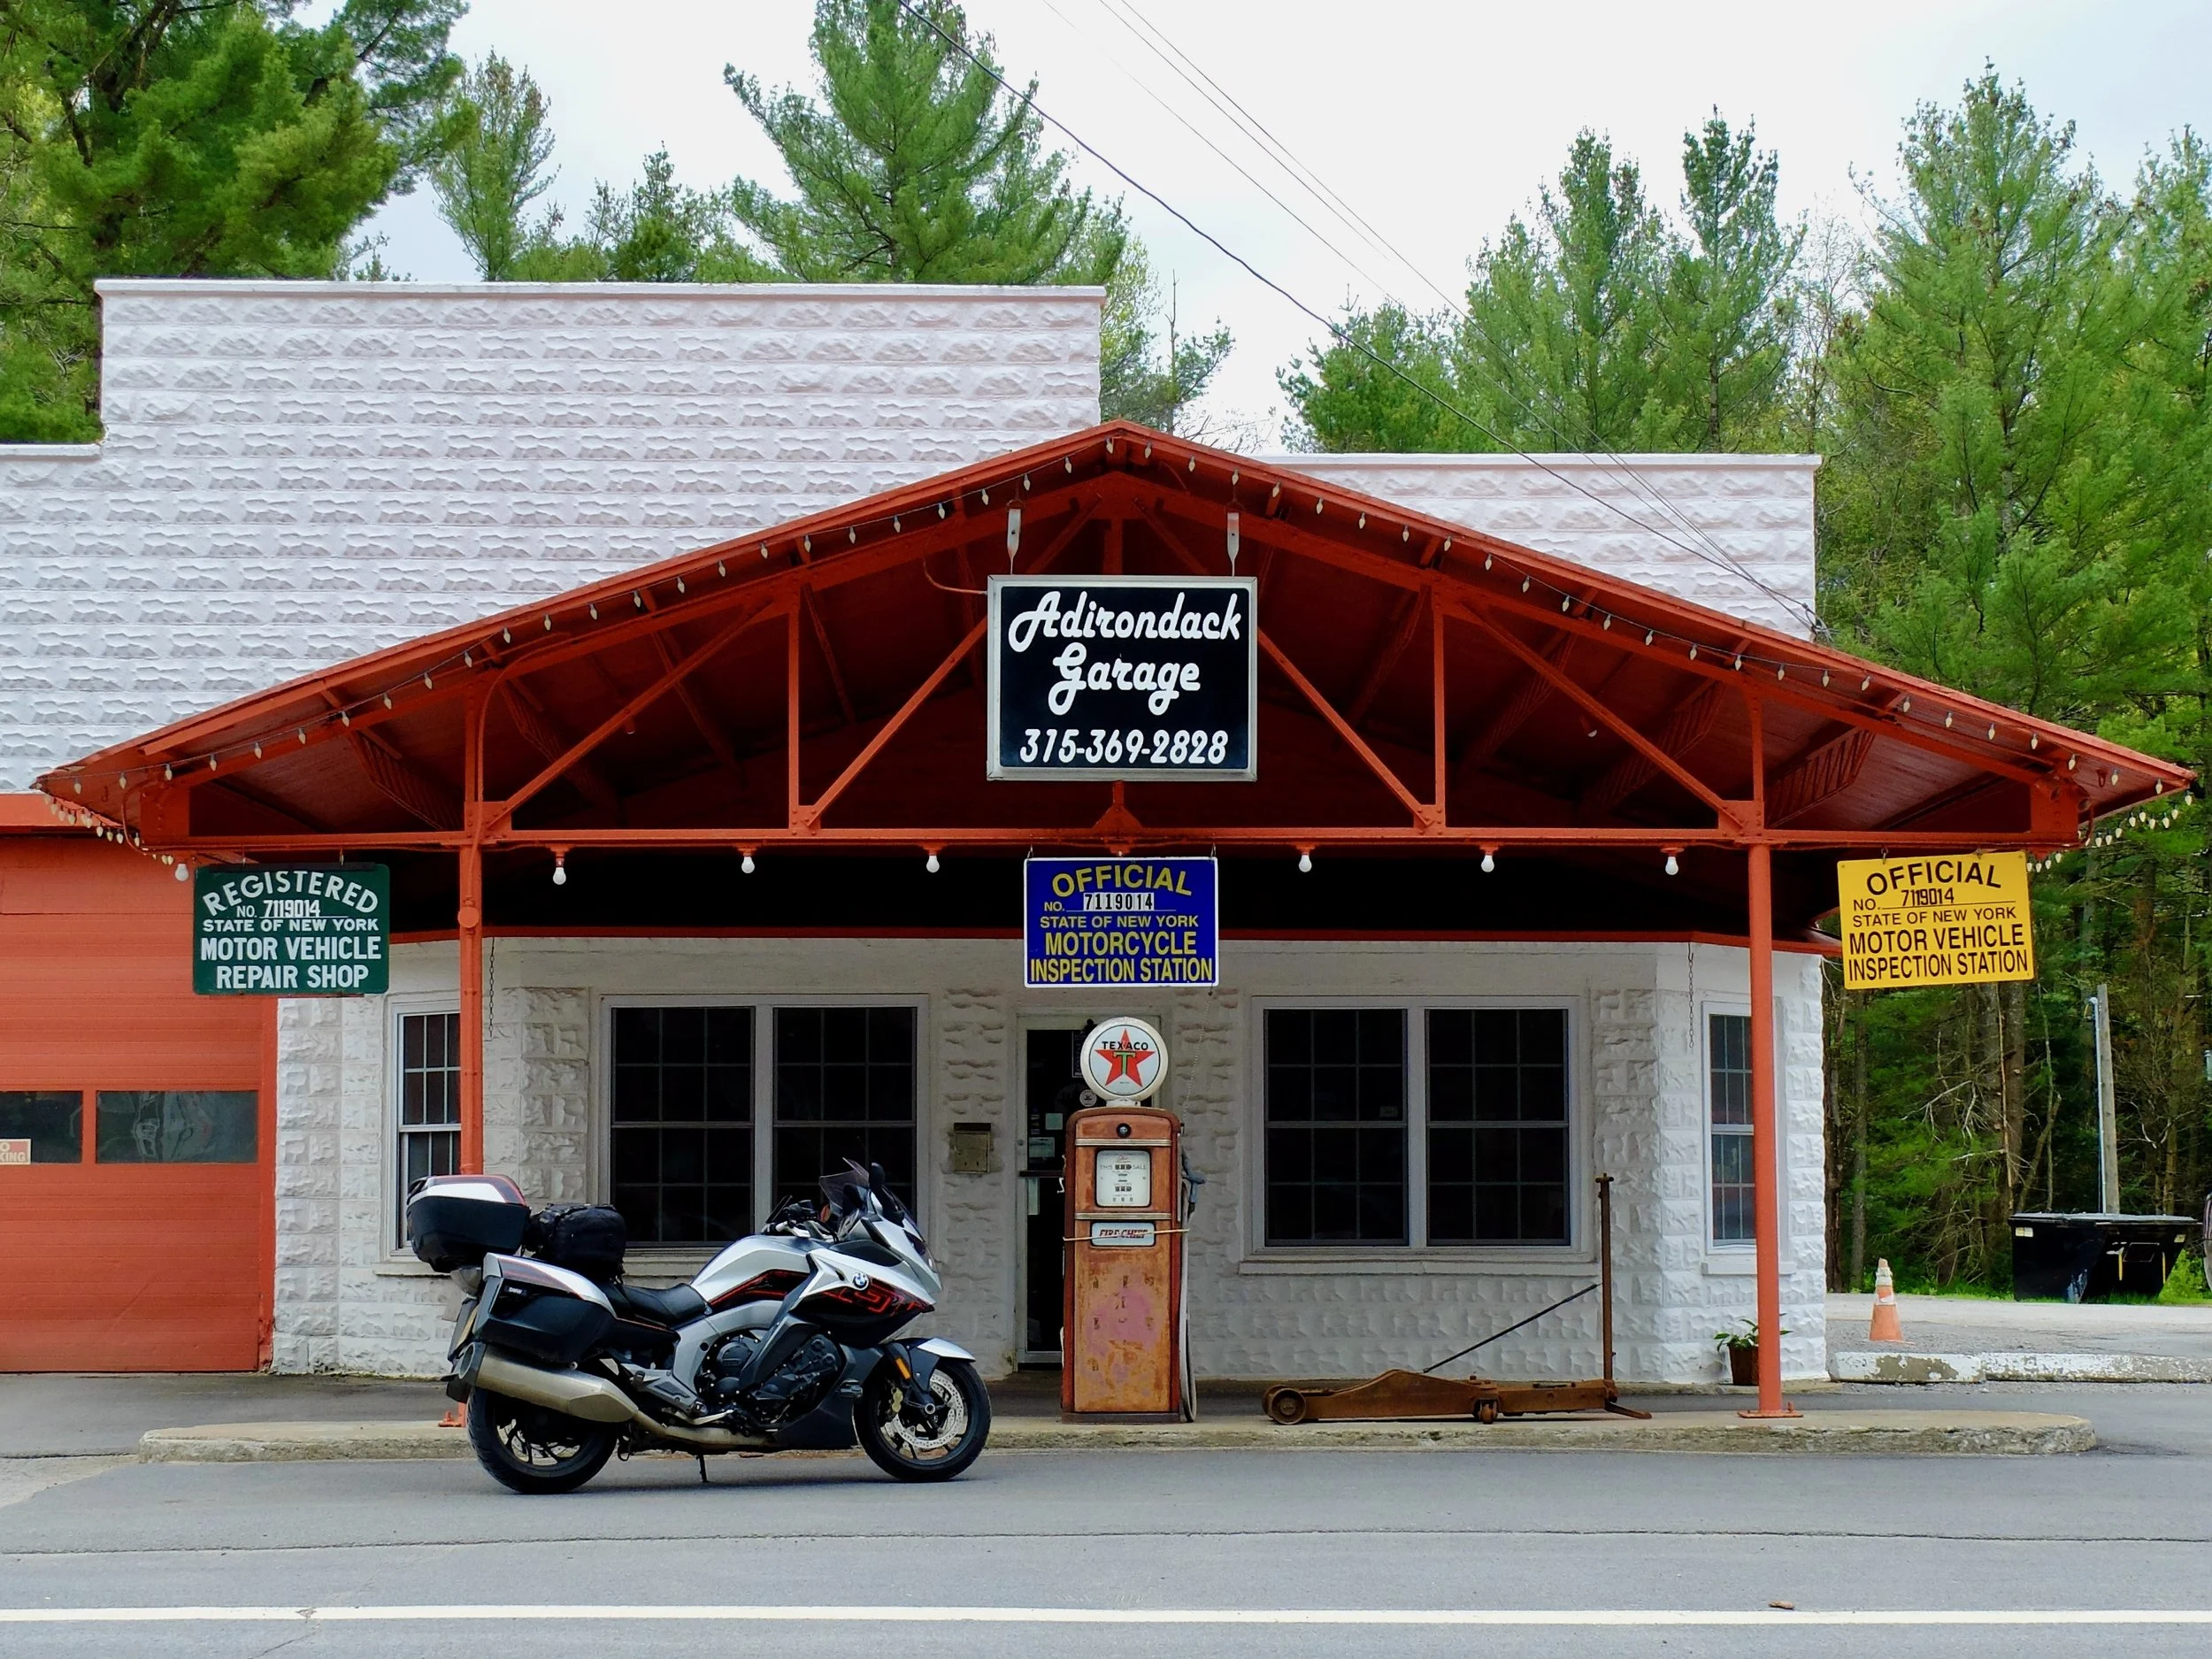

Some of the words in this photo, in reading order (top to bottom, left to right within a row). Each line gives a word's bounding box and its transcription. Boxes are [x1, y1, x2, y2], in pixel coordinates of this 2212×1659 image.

[1008, 590, 1241, 653] Adirondack
[1048, 641, 1202, 716] Garage
[1019, 728, 1229, 764] 315-369-2828
[1052, 864, 1193, 897] OFFICIAL
[1866, 860, 2002, 895] OFFICIAL
[203, 870, 379, 917] REGISTERED
[1044, 901, 1065, 912] NO.
[1084, 893, 1153, 910] 7119014
[1853, 898, 1881, 911] NO.
[1901, 887, 1955, 907] 7119014
[236, 904, 257, 918] NO.
[263, 899, 321, 918] 7119014
[1852, 912, 1901, 927] STATE
[1907, 910, 1928, 924] OF
[1932, 909, 1967, 923] NEW
[1974, 906, 2017, 920] YORK
[203, 918, 255, 933] STATE
[260, 918, 283, 932] OF
[289, 918, 326, 932] NEW
[333, 918, 380, 931] YORK
[1040, 916, 1087, 928] STATE
[1091, 916, 1112, 928] OF
[1117, 915, 1151, 927] NEW
[1156, 915, 1199, 927] YORK
[200, 936, 278, 961] MOTOR
[284, 935, 382, 960] VEHICLE
[1045, 931, 1197, 956] MOTORCYCLE
[1849, 928, 1928, 955] MOTOR
[1932, 923, 2025, 950] VEHICLE
[216, 965, 299, 989] REPAIR
[306, 964, 370, 988] SHOP
[1030, 958, 1135, 982] INSPECTION
[1140, 957, 1213, 982] STATION
[1848, 953, 1952, 982] INSPECTION
[1956, 949, 2029, 976] STATION
[1102, 1041, 1148, 1051] TEXACO
